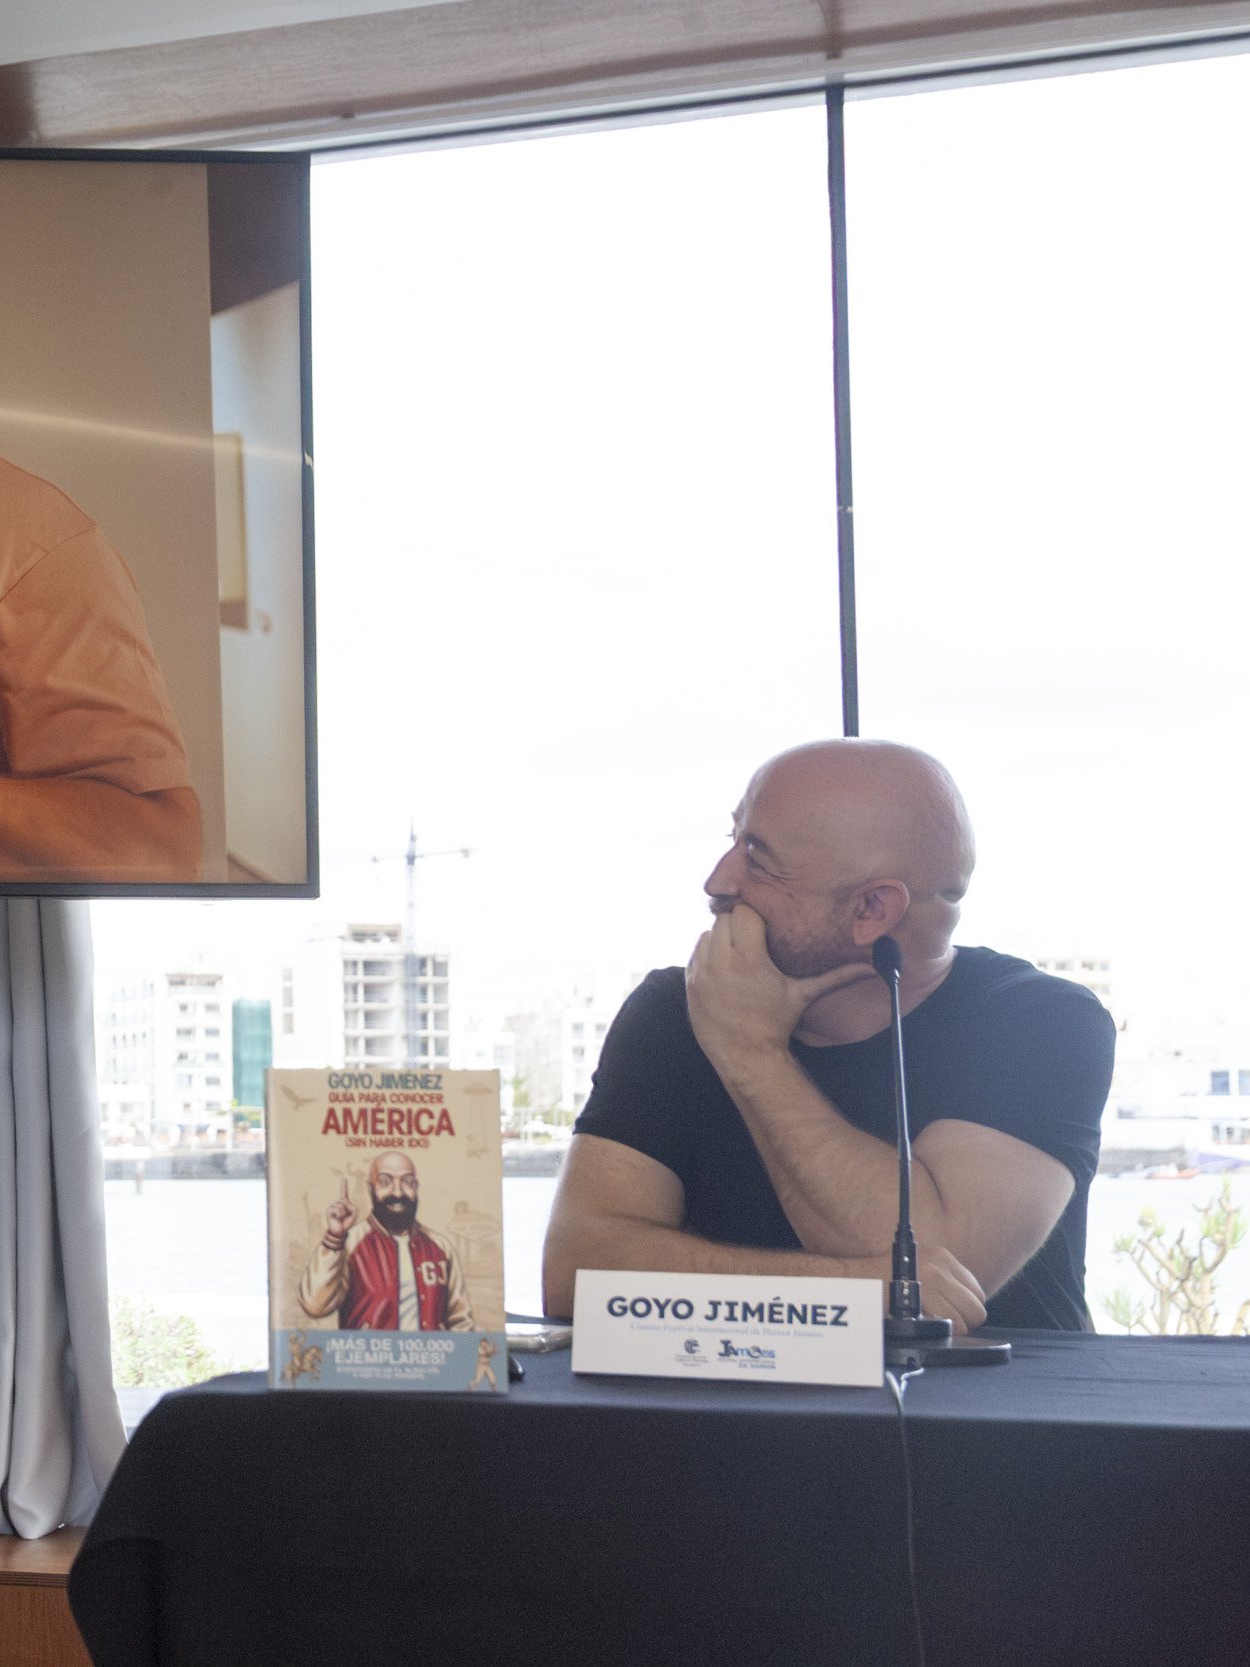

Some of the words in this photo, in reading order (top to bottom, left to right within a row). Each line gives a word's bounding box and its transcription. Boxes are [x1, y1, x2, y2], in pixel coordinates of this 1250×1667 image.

[328, 1073, 372, 1089] GOYO
[375, 1070, 442, 1090] JIMÉNEZ
[358, 1092, 387, 1103] PARA
[390, 1093, 444, 1104] CONOCER
[321, 1102, 456, 1136] AMÉRICA
[369, 1138, 405, 1148] HABER
[607, 1296, 694, 1320] GOYO
[704, 1296, 849, 1327] JIMÉNEZ
[370, 1338, 391, 1351] DE
[398, 1338, 455, 1353] 100.000
[334, 1351, 446, 1364] EJEMPLARES!
